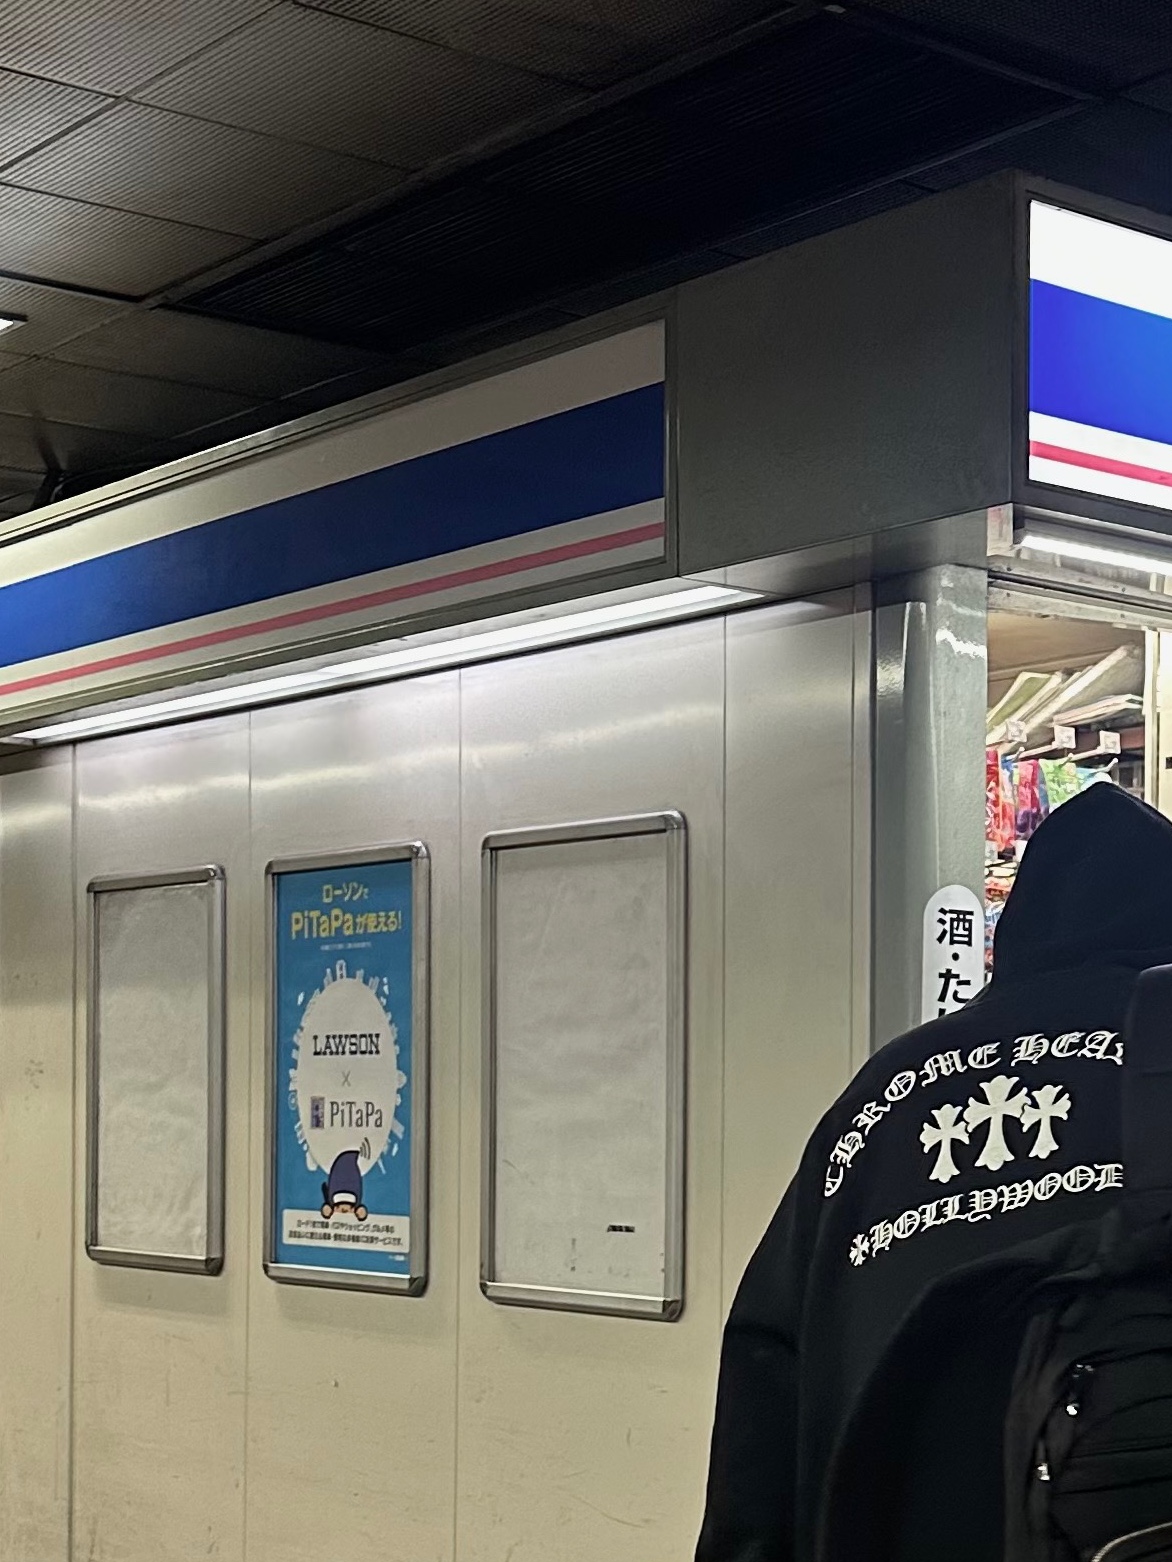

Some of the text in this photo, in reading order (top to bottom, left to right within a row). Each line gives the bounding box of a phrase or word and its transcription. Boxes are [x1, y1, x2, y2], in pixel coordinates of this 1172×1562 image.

[312, 1032, 381, 1057] LAWSON
[329, 1100, 383, 1129] PiTaPa
[824, 1042, 1001, 1197] CHROME
